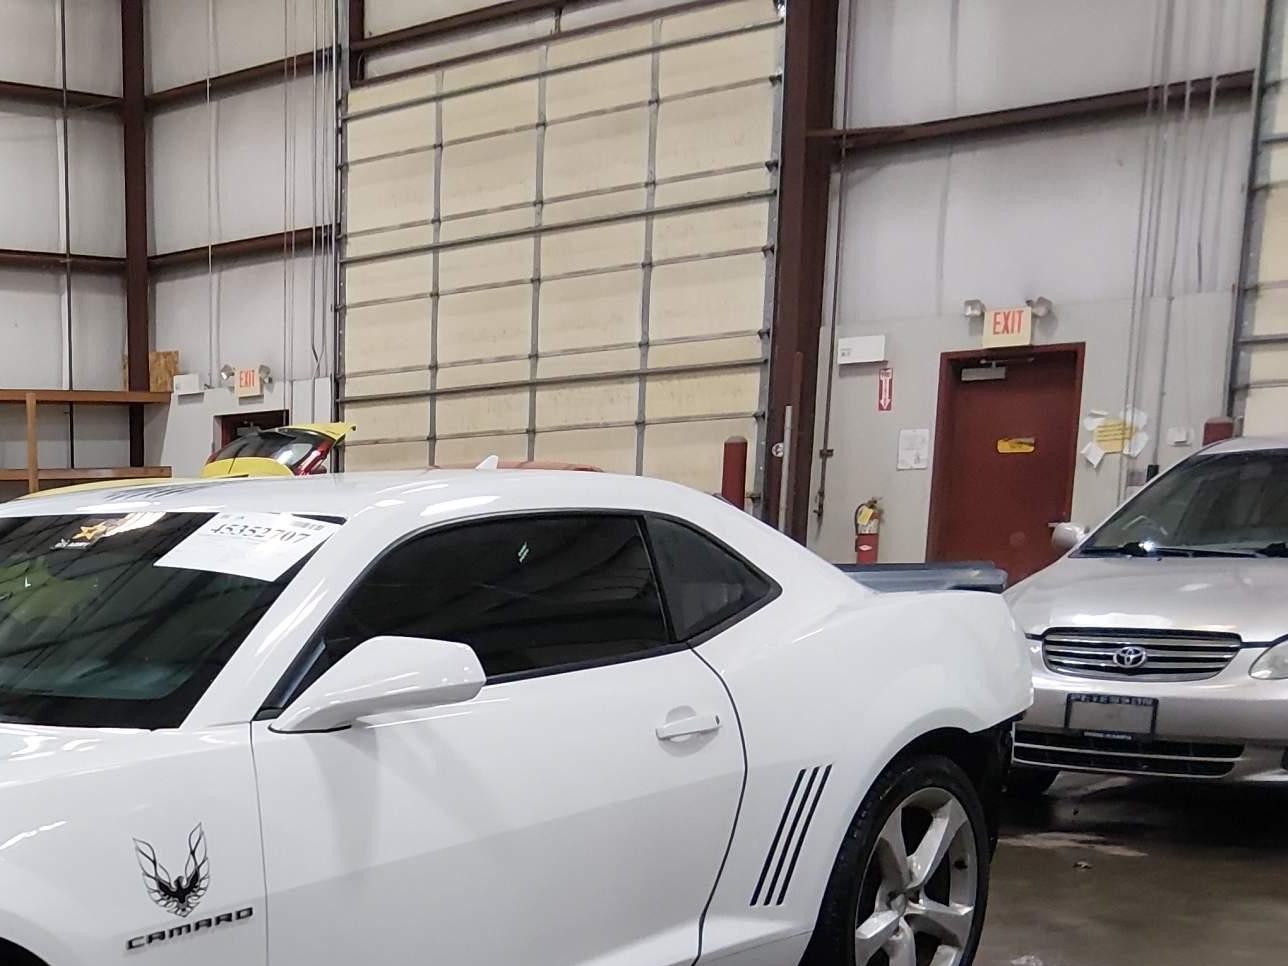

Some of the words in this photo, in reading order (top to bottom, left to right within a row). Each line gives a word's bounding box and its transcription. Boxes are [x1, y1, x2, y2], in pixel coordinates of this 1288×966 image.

[992, 309, 1024, 335] EXIT
[239, 369, 255, 388] EXIT
[211, 523, 311, 544] 45352707
[126, 906, 253, 951] CAMARO
